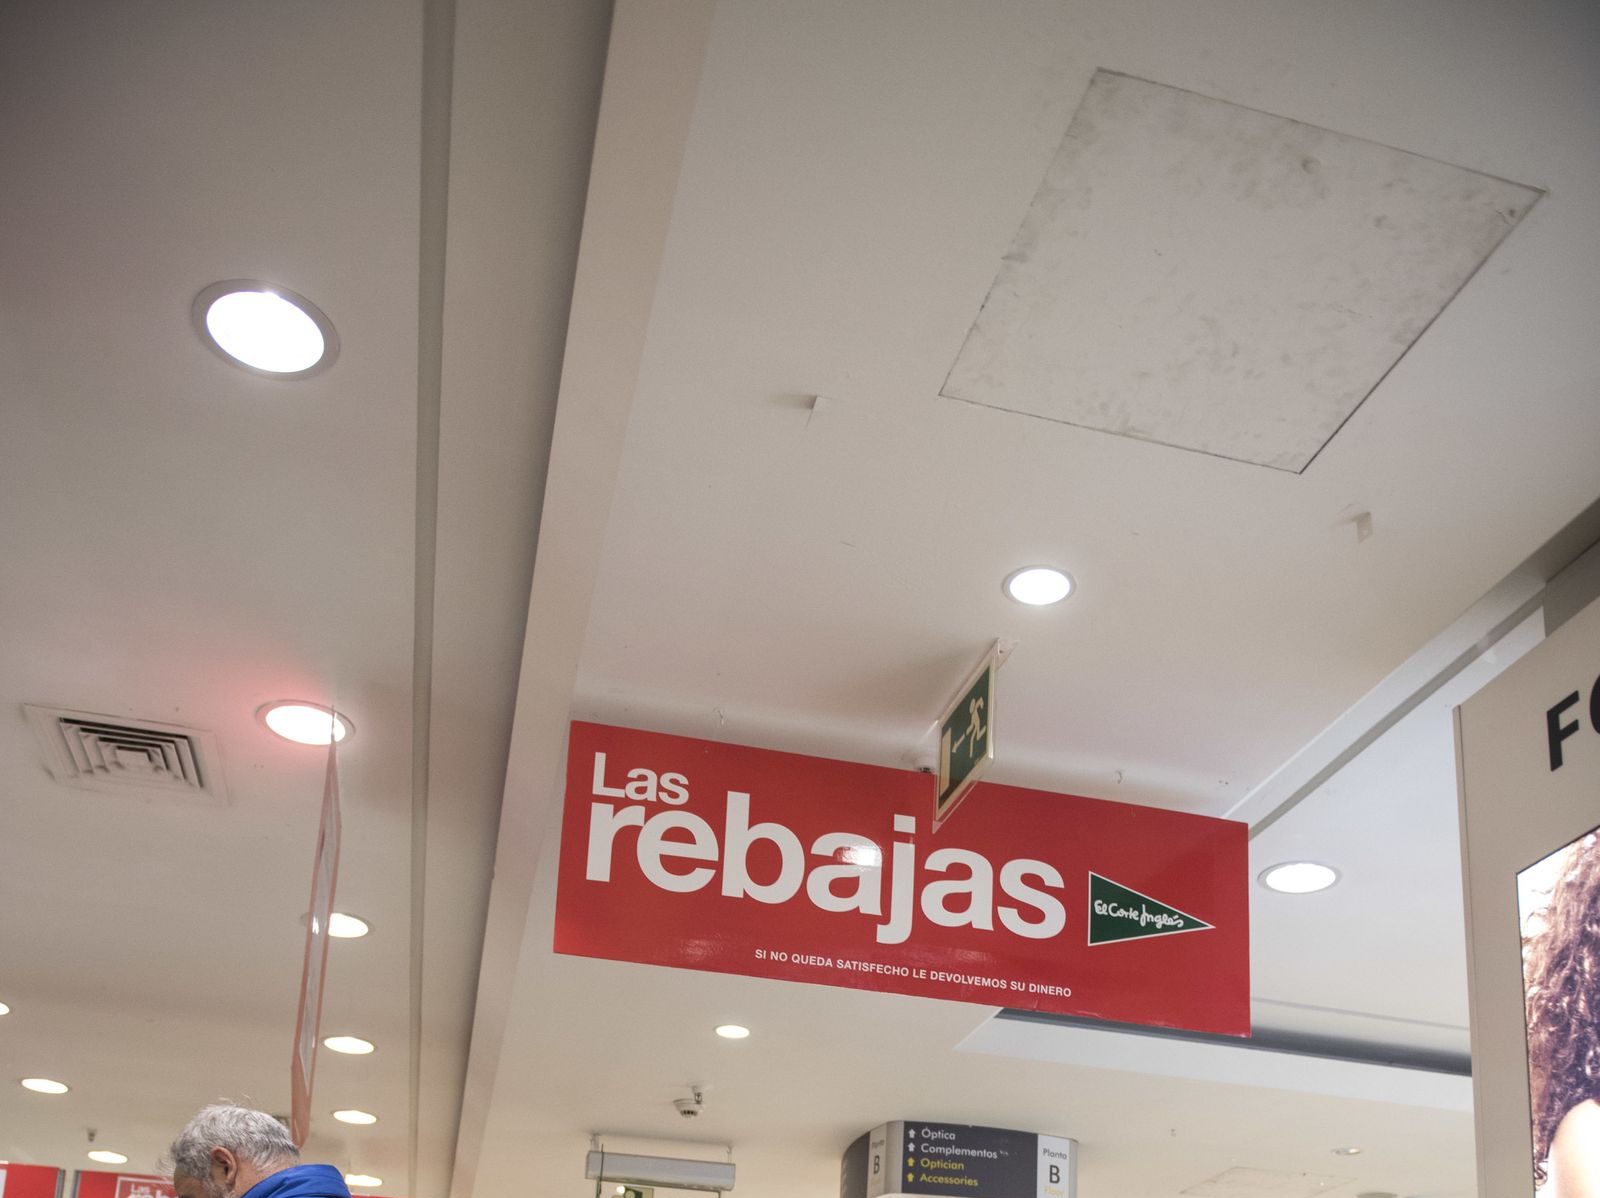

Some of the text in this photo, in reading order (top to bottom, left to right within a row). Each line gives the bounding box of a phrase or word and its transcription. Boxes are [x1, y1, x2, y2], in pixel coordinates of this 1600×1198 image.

[592, 751, 690, 805] Las
[586, 790, 1067, 945] rebajas
[1094, 899, 1184, 929] El Corte Inglés
[754, 948, 1072, 998] SI NO QUEDA SATISFECHO LE DEVOLVEMOS SU DINERO
[921, 1127, 956, 1141] Óptica
[920, 1143, 998, 1159] Complementos
[1042, 1147, 1068, 1160] Planta
[873, 1154, 880, 1175] B
[920, 1157, 965, 1171] Optician
[1049, 1164, 1060, 1184] B
[919, 1173, 979, 1187] Accessories
